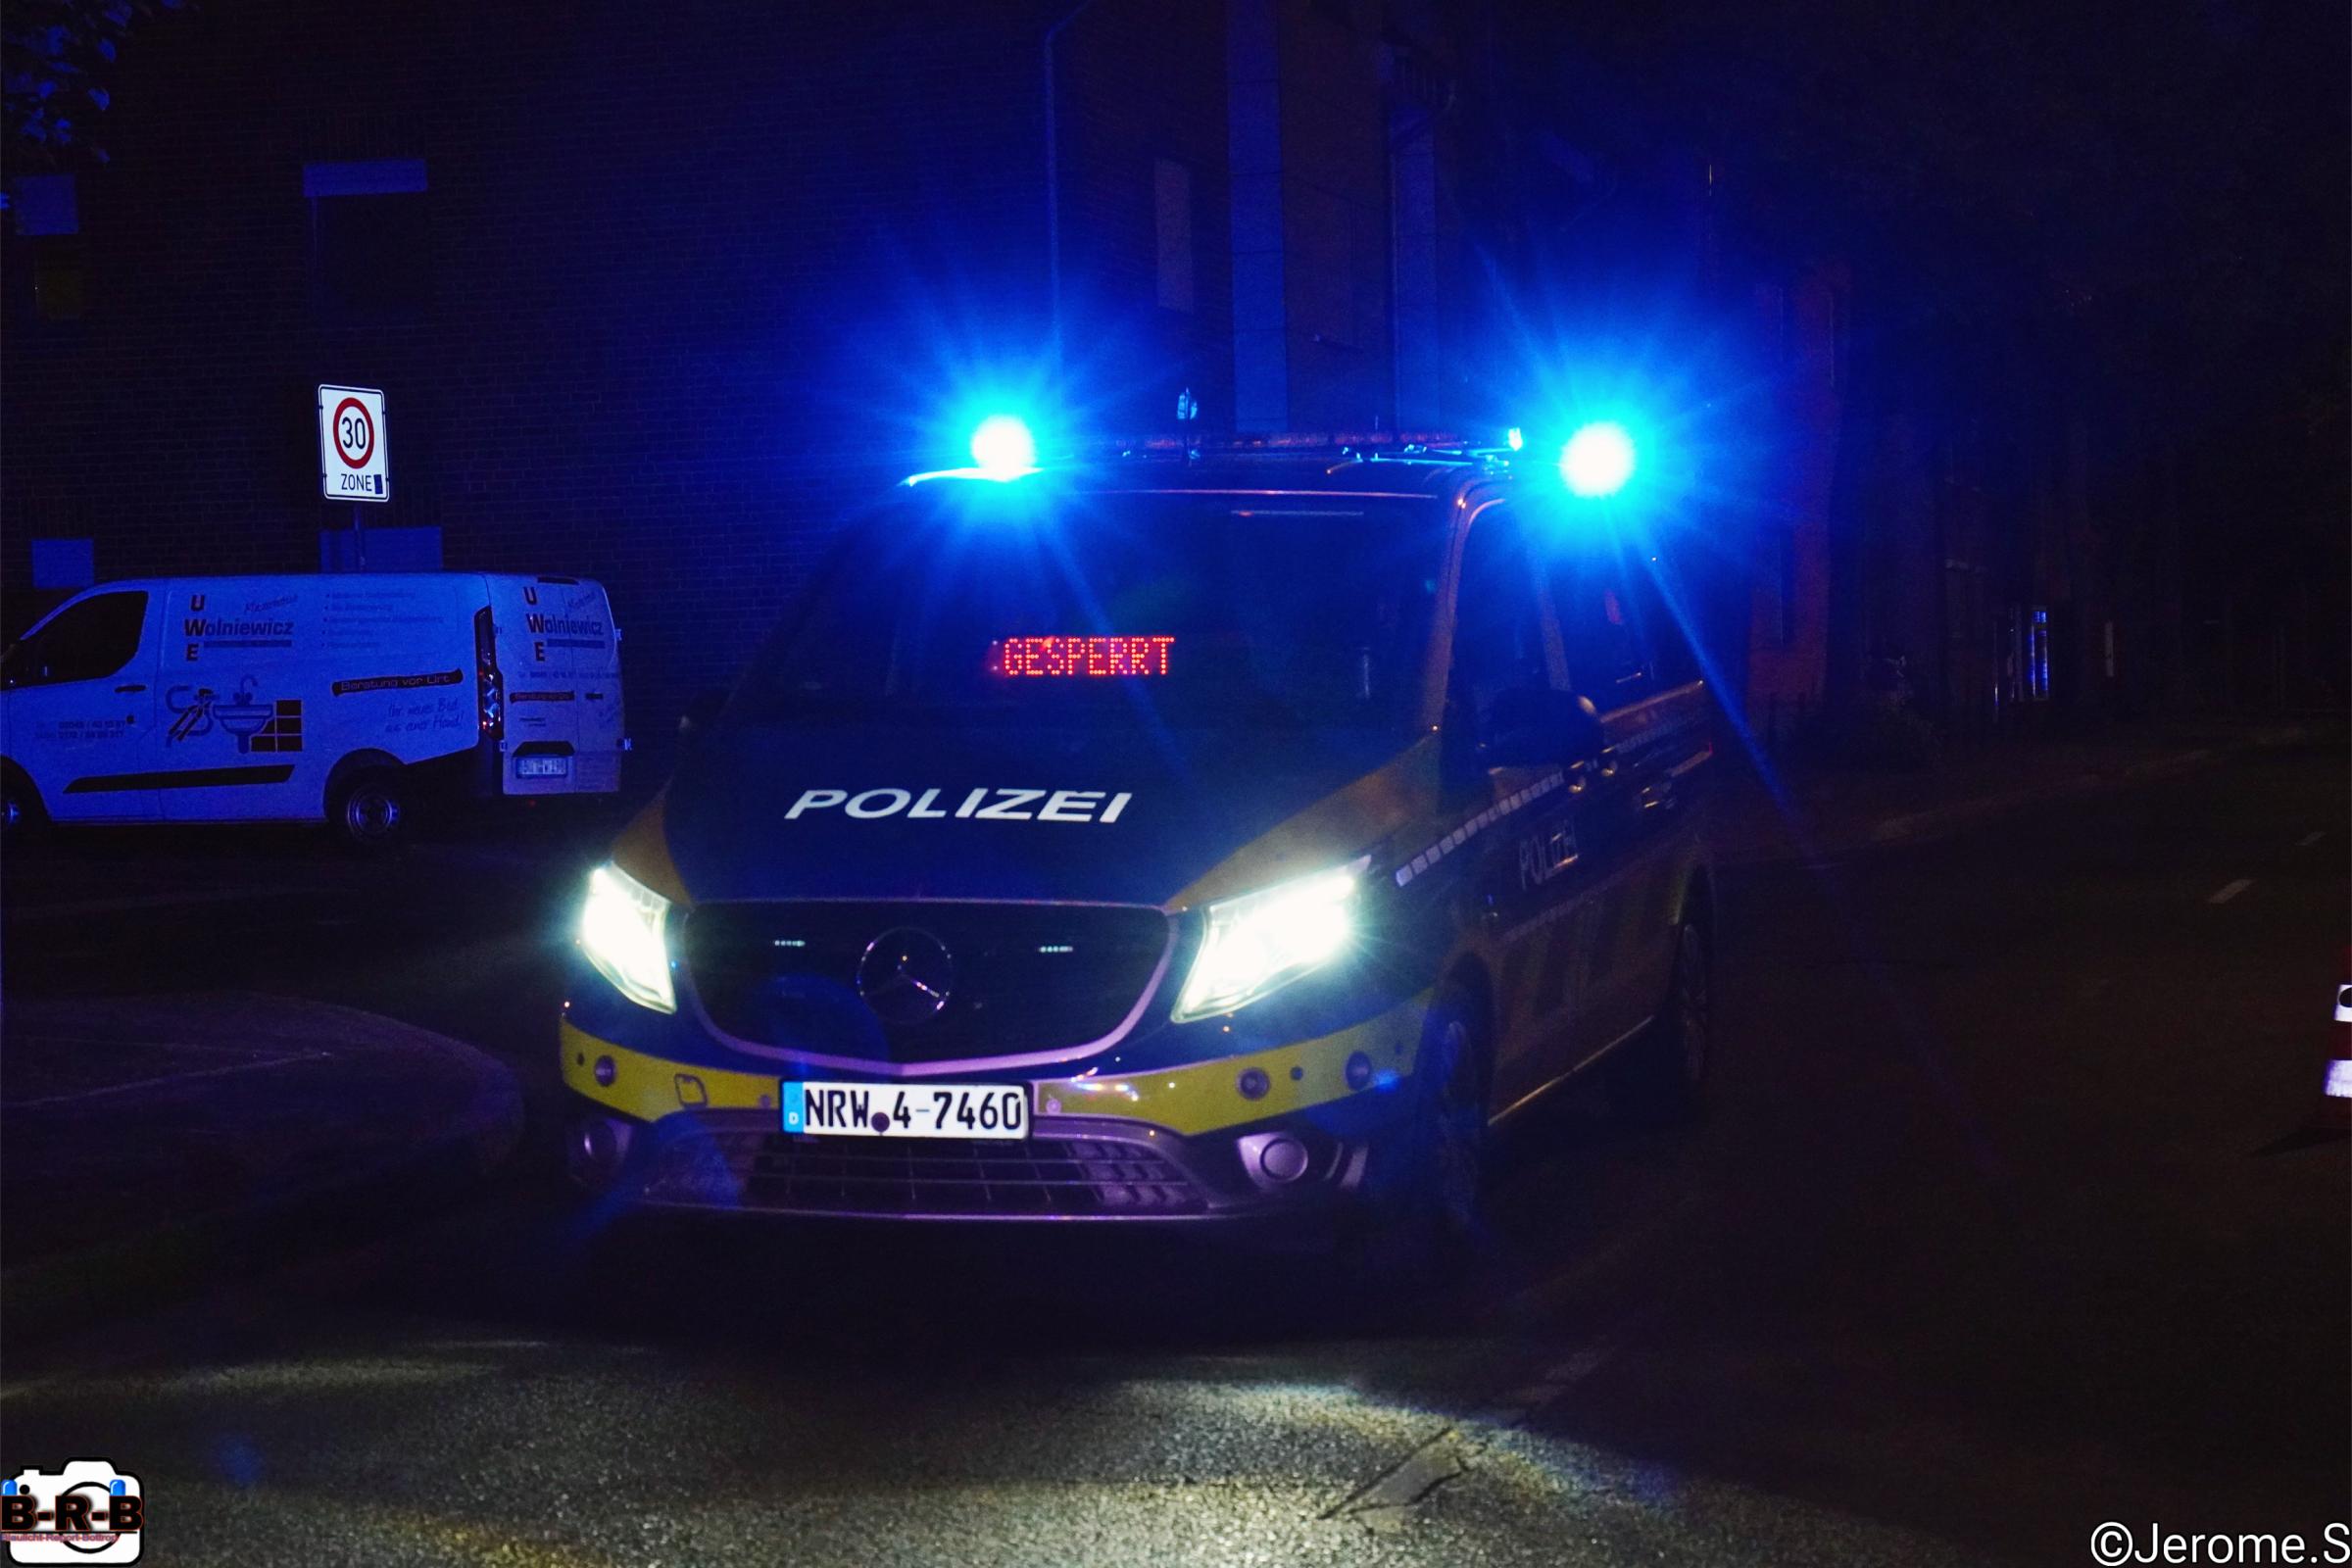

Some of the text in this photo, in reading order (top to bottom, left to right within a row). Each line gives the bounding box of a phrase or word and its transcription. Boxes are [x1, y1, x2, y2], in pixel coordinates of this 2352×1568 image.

[341, 416, 367, 450] 30
[340, 473, 372, 492] ZONE
[190, 594, 207, 612] U
[523, 585, 538, 606] U
[184, 617, 295, 637] Wolniewicz
[525, 612, 605, 636] Wolniewicz
[186, 643, 200, 662] E
[534, 641, 546, 662] E
[1004, 636, 1176, 676] GESPERRT
[341, 674, 399, 692] Beratung
[783, 787, 1133, 823] POLIZEI
[805, 1089, 869, 1128] NRW
